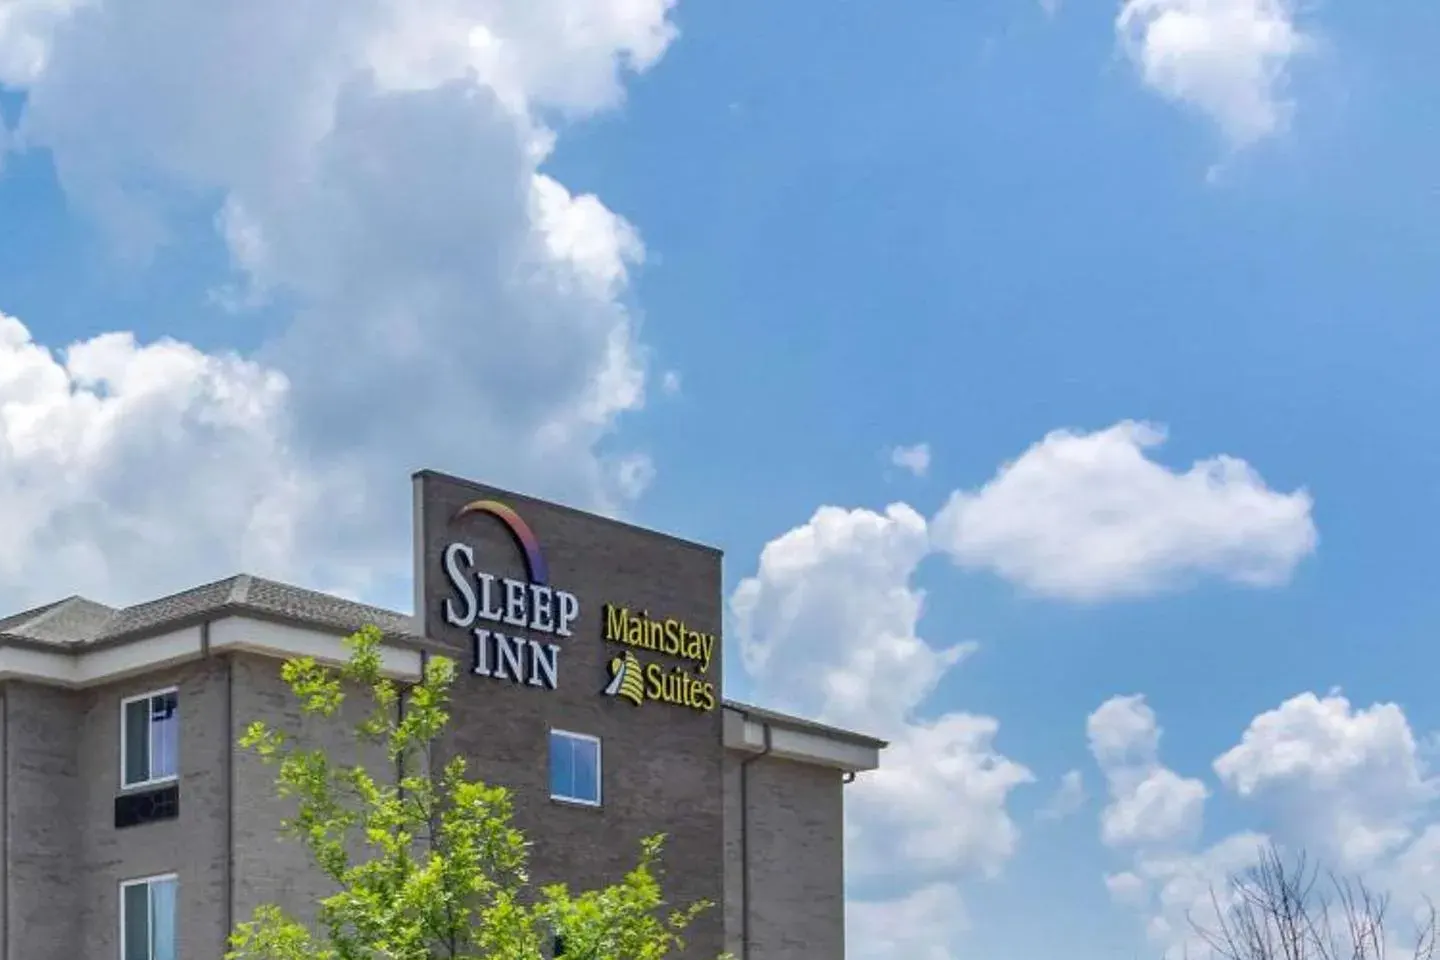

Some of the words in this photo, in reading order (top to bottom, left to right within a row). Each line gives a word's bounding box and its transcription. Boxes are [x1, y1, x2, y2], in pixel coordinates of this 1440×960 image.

[444, 542, 580, 637] SLEEP
[474, 628, 561, 690] INN
[605, 603, 714, 672] MainStay
[646, 662, 715, 711] Suites
